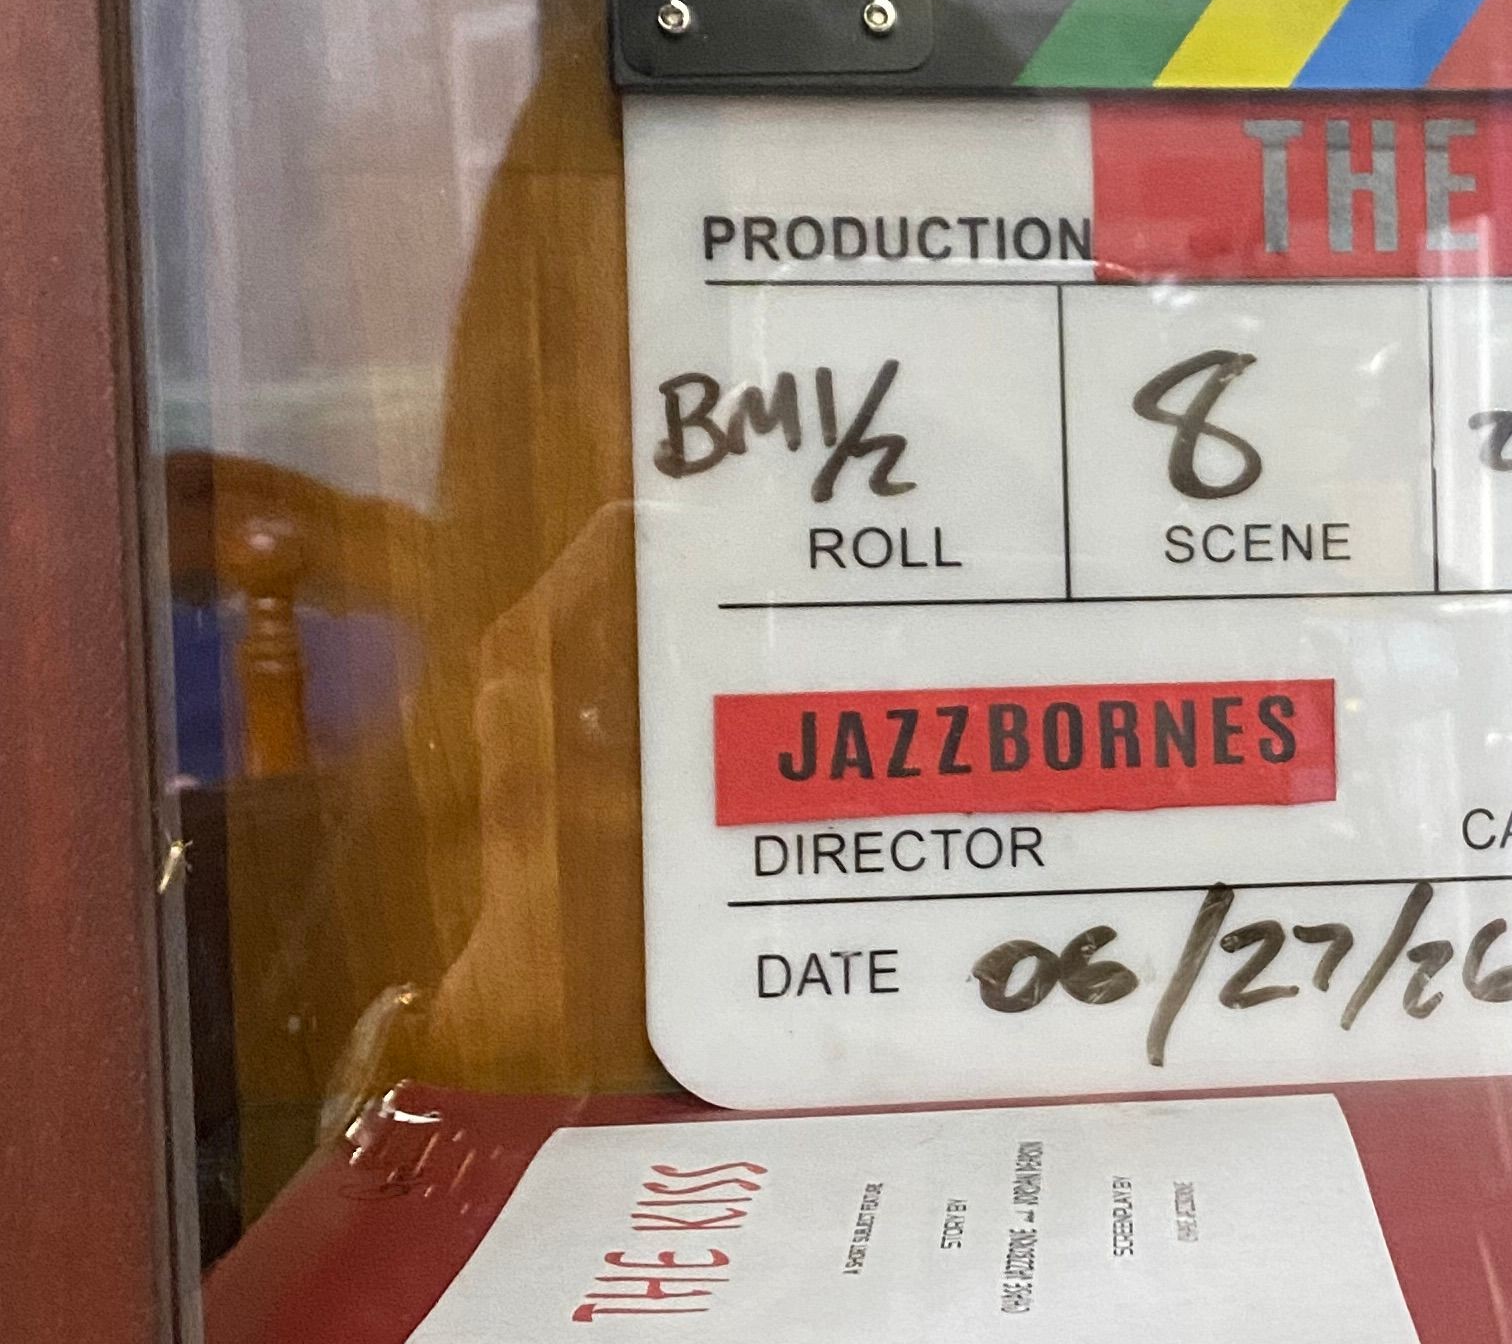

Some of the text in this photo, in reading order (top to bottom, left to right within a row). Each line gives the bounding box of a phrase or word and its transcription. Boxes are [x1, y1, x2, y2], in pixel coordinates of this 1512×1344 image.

[1243, 116, 1481, 254] THE
[703, 215, 1093, 262] PRODUCTION
[1132, 349, 1263, 500] 8
[808, 526, 963, 570] ROLL
[1163, 523, 1352, 564] SCENE
[778, 693, 1298, 783] JAZZBORNES
[753, 825, 1046, 877] DIRECTOR
[756, 949, 901, 999] DATE
[571, 1160, 769, 1323] THE KISS
[940, 1197, 969, 1249] STORY BY
[1112, 1175, 1134, 1257] SCREENPLAY BY
